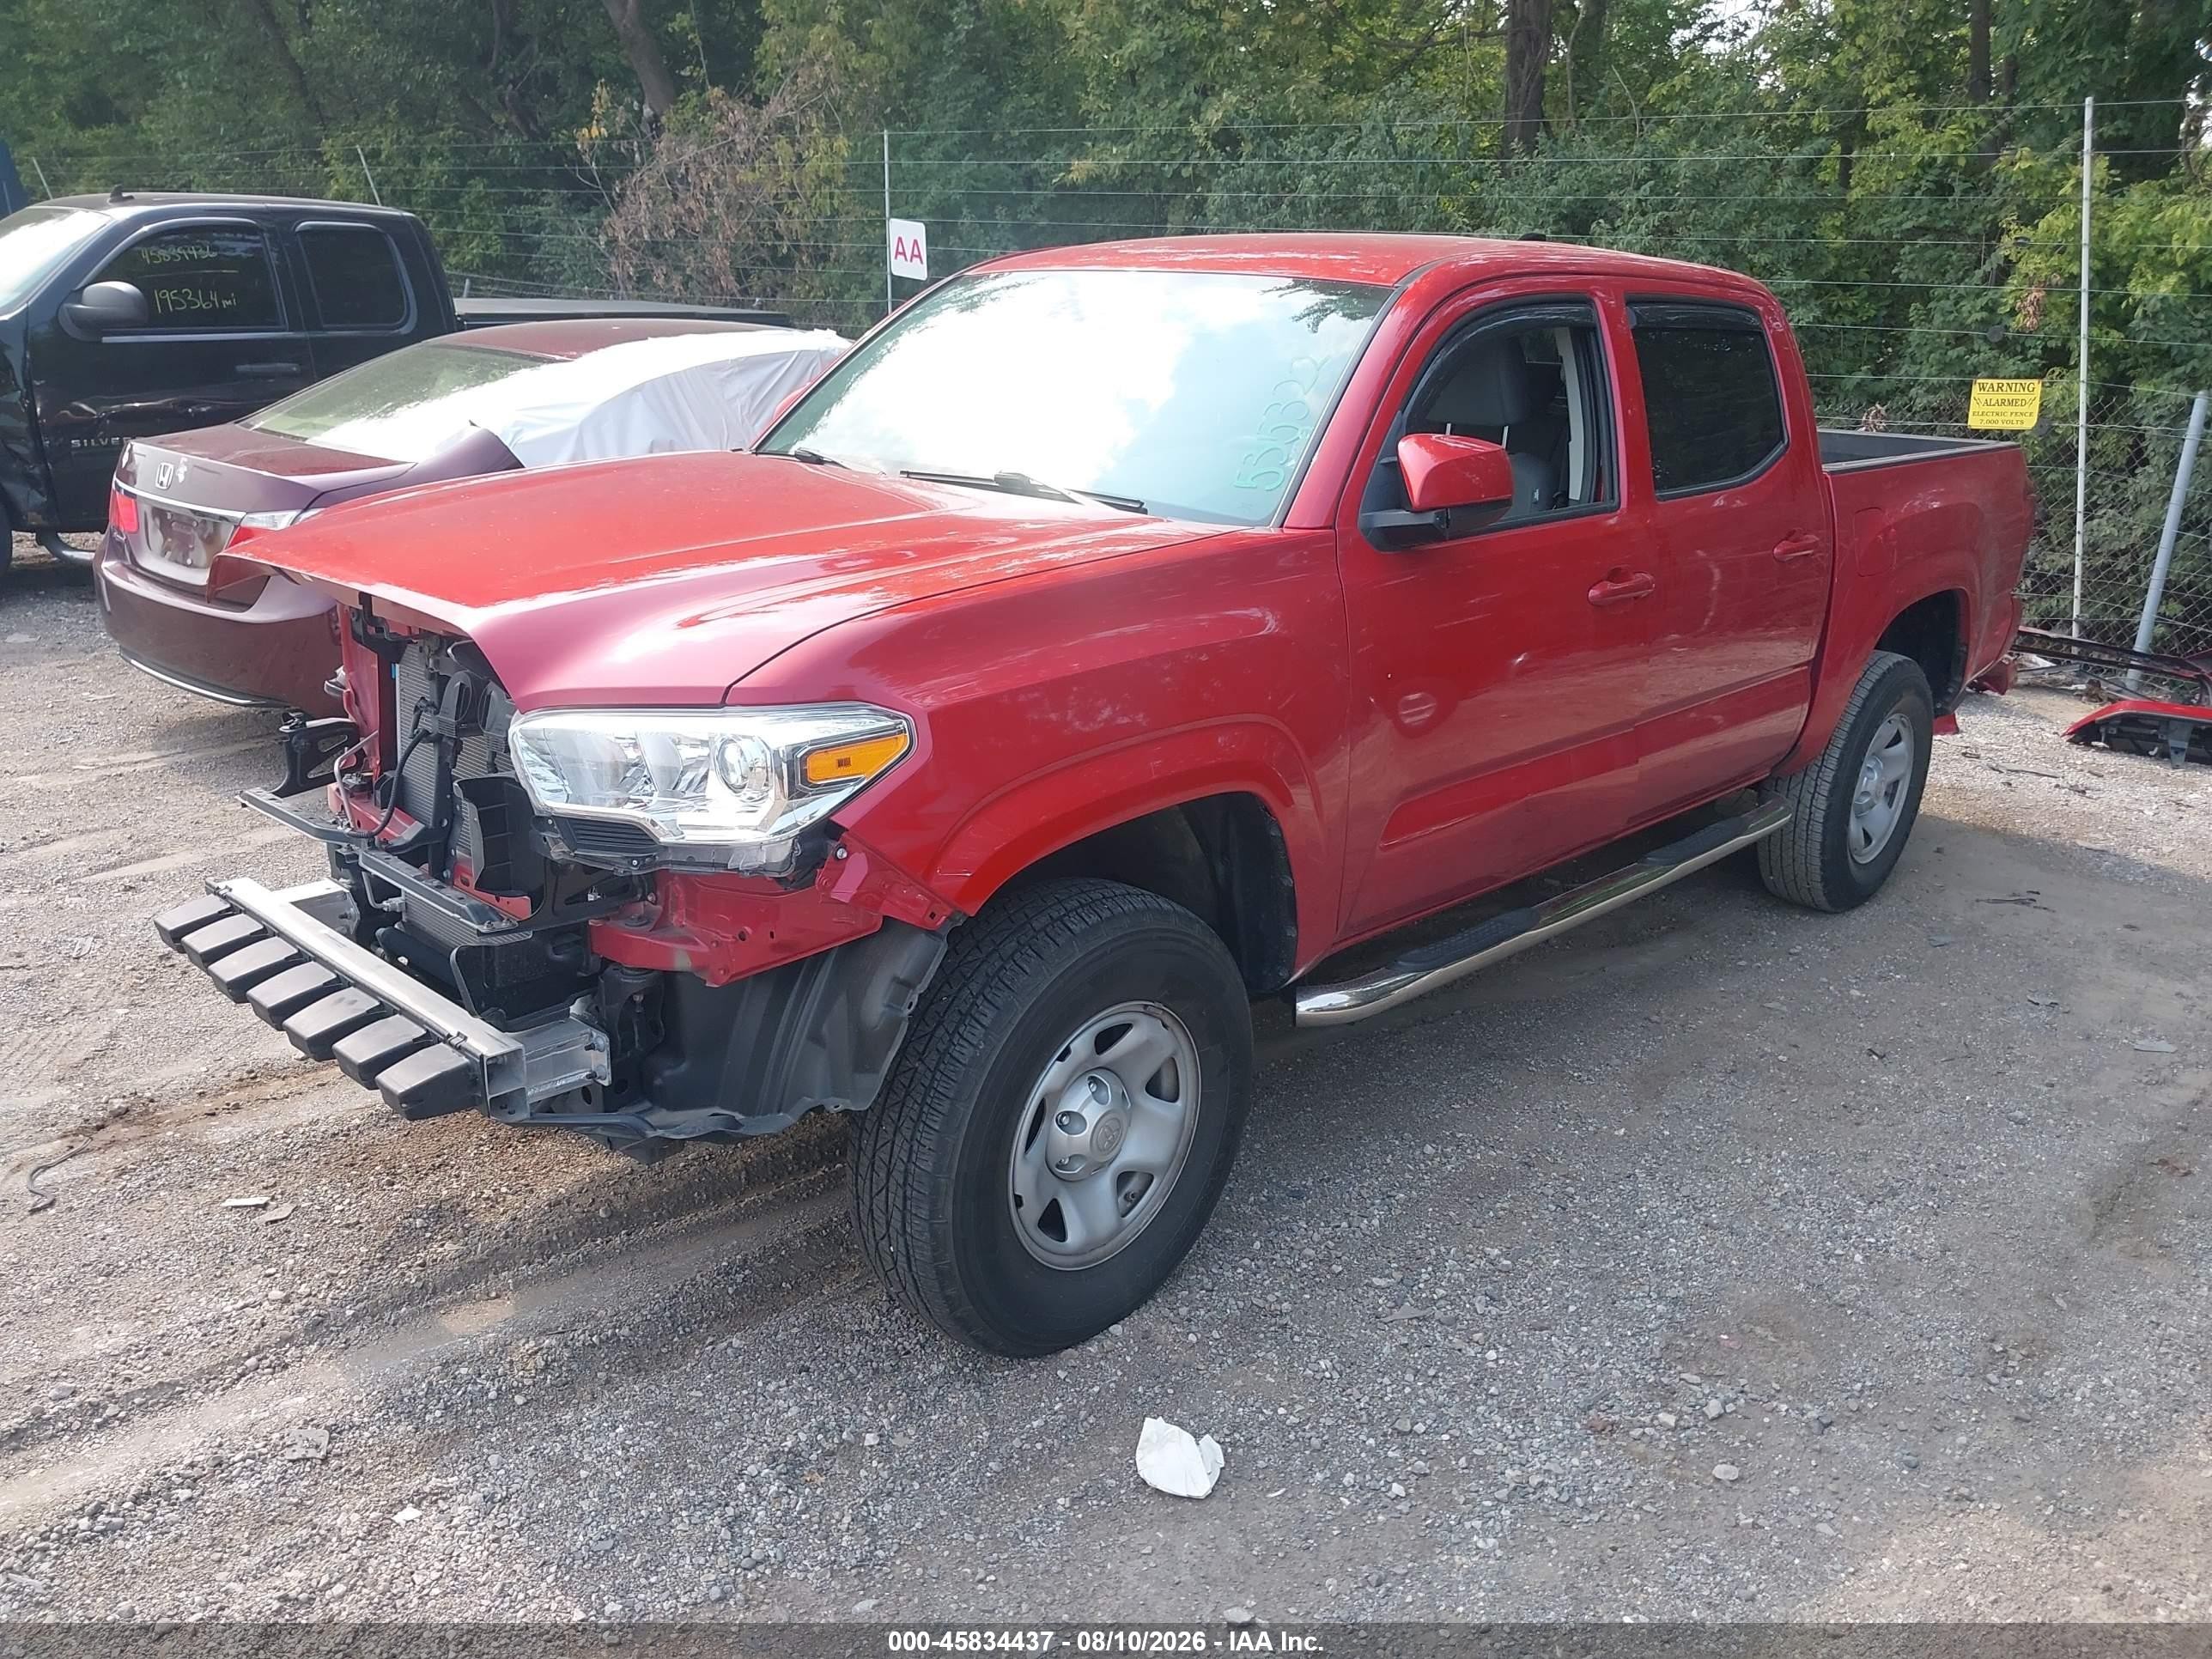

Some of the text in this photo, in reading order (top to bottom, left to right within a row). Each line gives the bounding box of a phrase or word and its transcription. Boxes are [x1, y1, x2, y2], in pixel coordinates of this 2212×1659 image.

[894, 235, 924, 265] AA
[1977, 381, 2036, 393] WARNING
[1982, 398, 2027, 407] ALARMED
